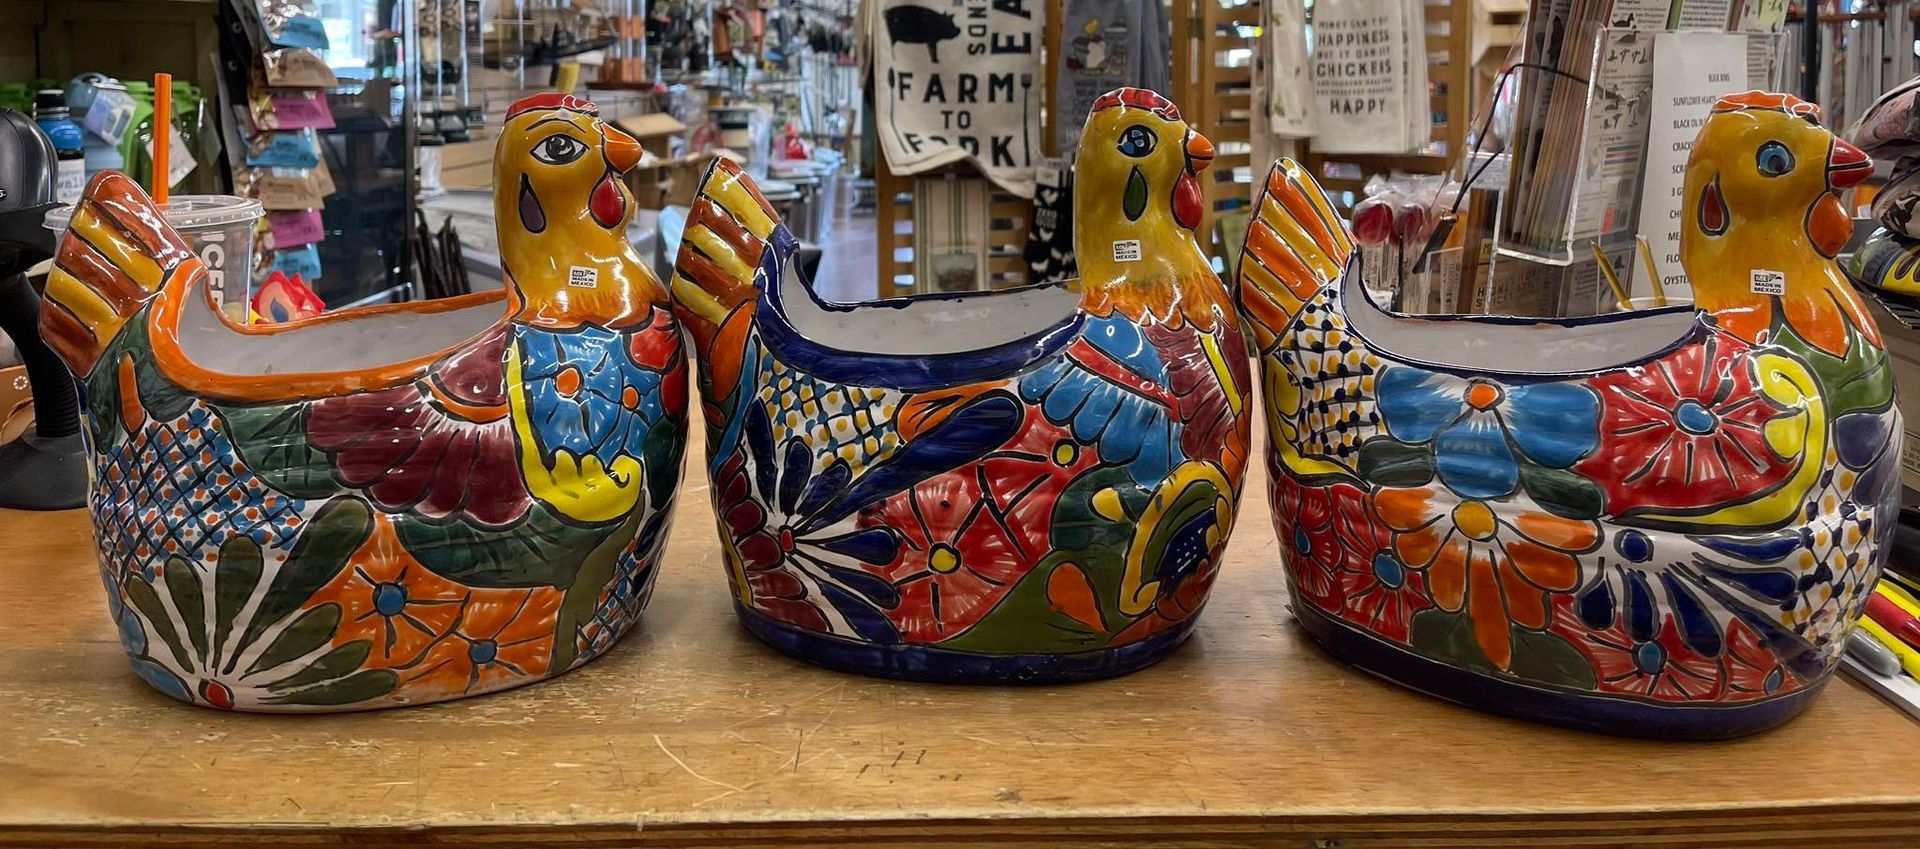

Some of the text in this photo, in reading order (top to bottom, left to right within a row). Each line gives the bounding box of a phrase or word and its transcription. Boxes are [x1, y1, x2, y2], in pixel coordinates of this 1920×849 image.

[967, 0, 986, 56] NDS
[1318, 30, 1390, 46] HAPPINESS
[1316, 59, 1392, 77] CHICKENS
[898, 72, 1014, 103] FARM
[1330, 98, 1386, 114] HAPPY
[1673, 96, 1701, 106] SUNFLOWER
[941, 110, 971, 129] TO
[1673, 119, 1690, 129] BLACK
[1671, 187, 1676, 197] 3
